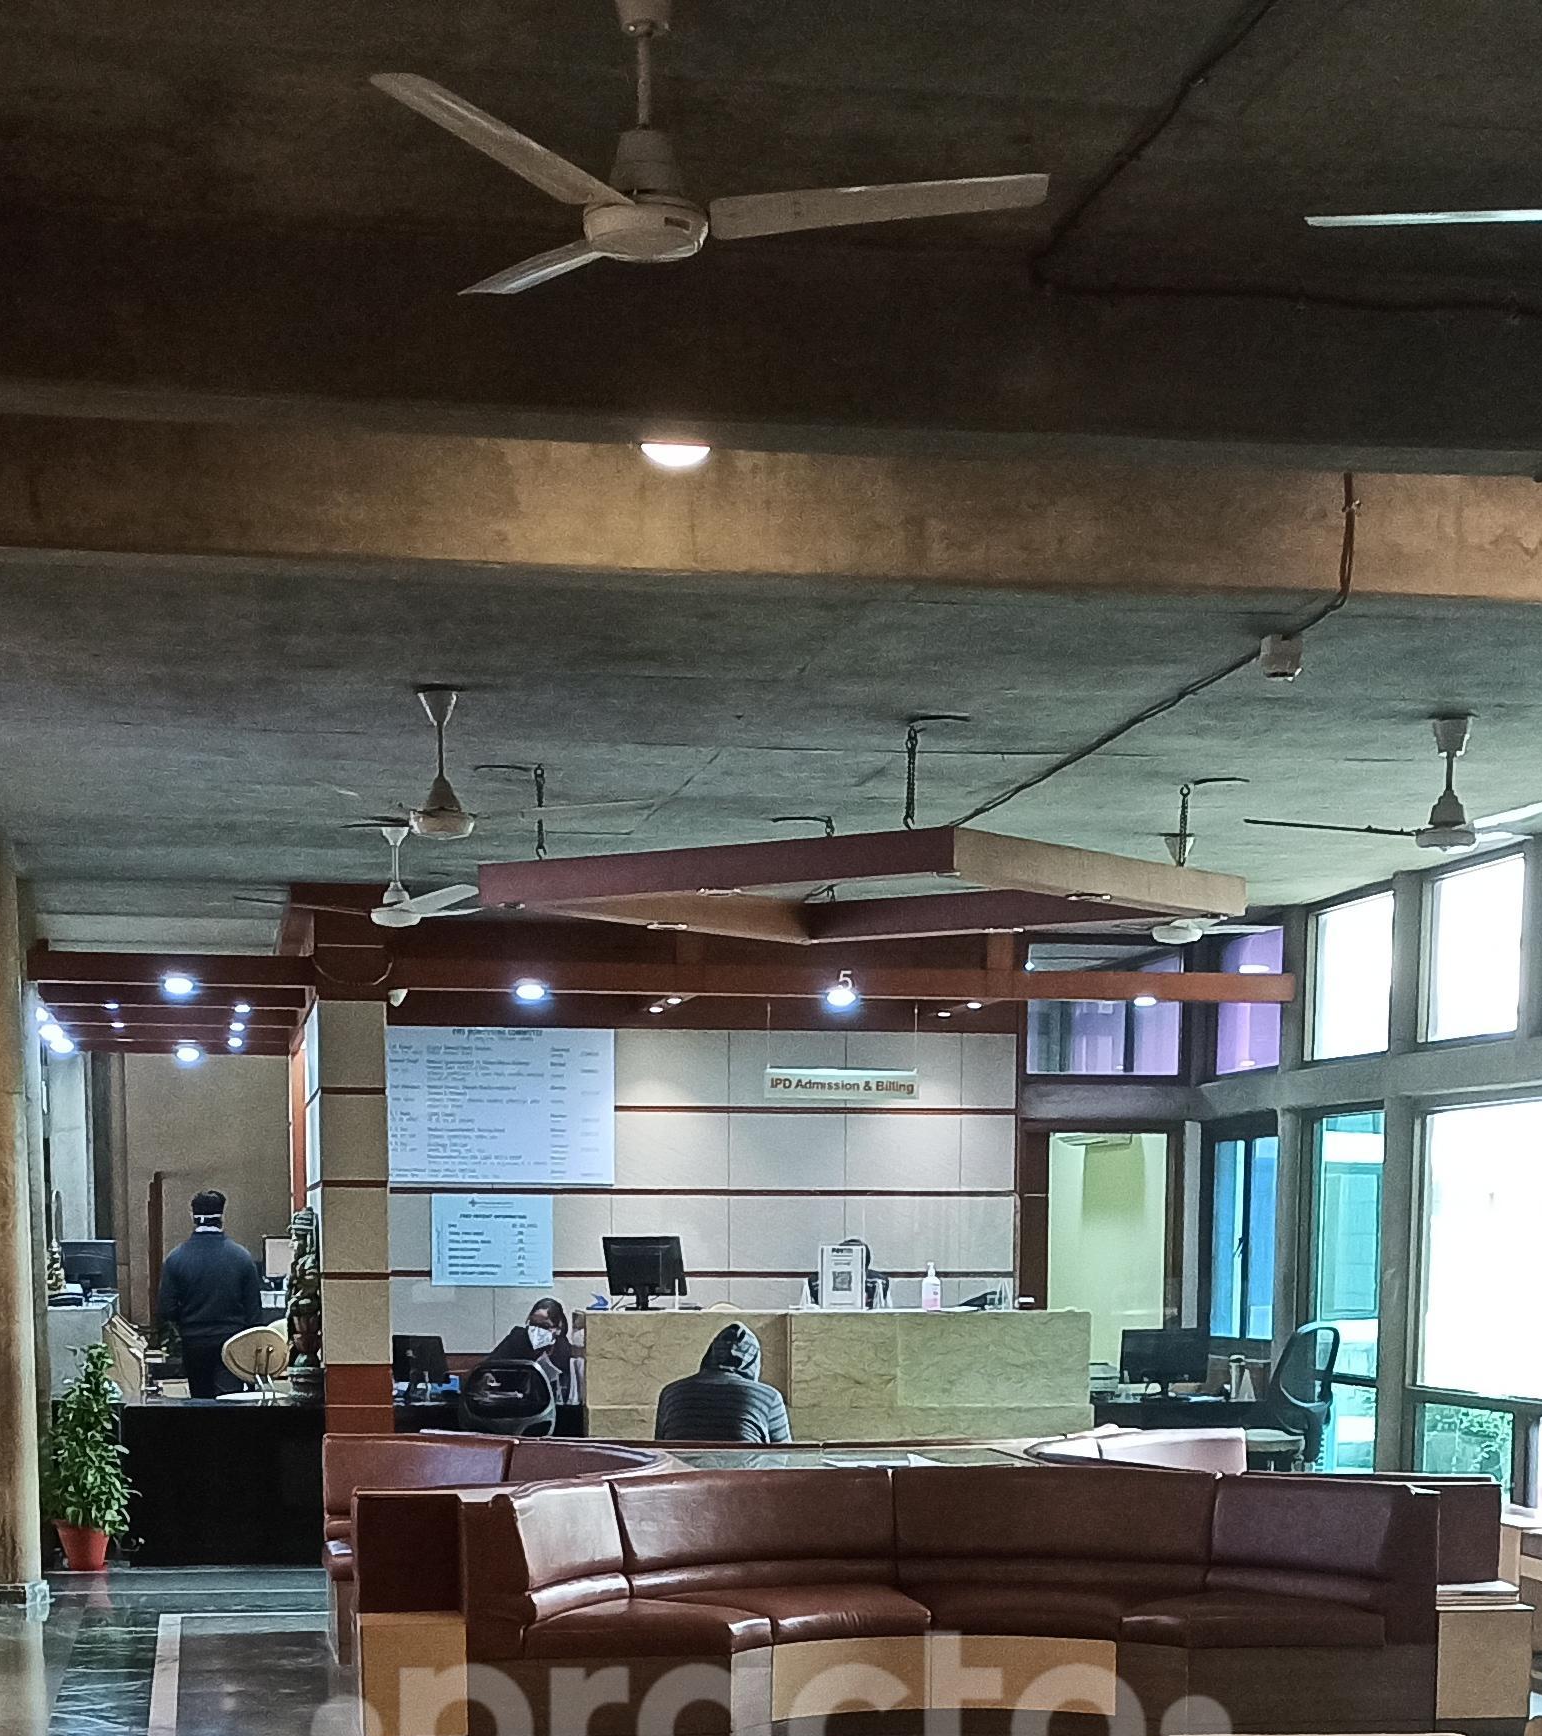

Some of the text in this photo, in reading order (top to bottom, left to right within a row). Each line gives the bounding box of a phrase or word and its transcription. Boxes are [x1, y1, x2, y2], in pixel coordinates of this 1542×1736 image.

[770, 1077, 915, 1094] IPD Admission & Billing
